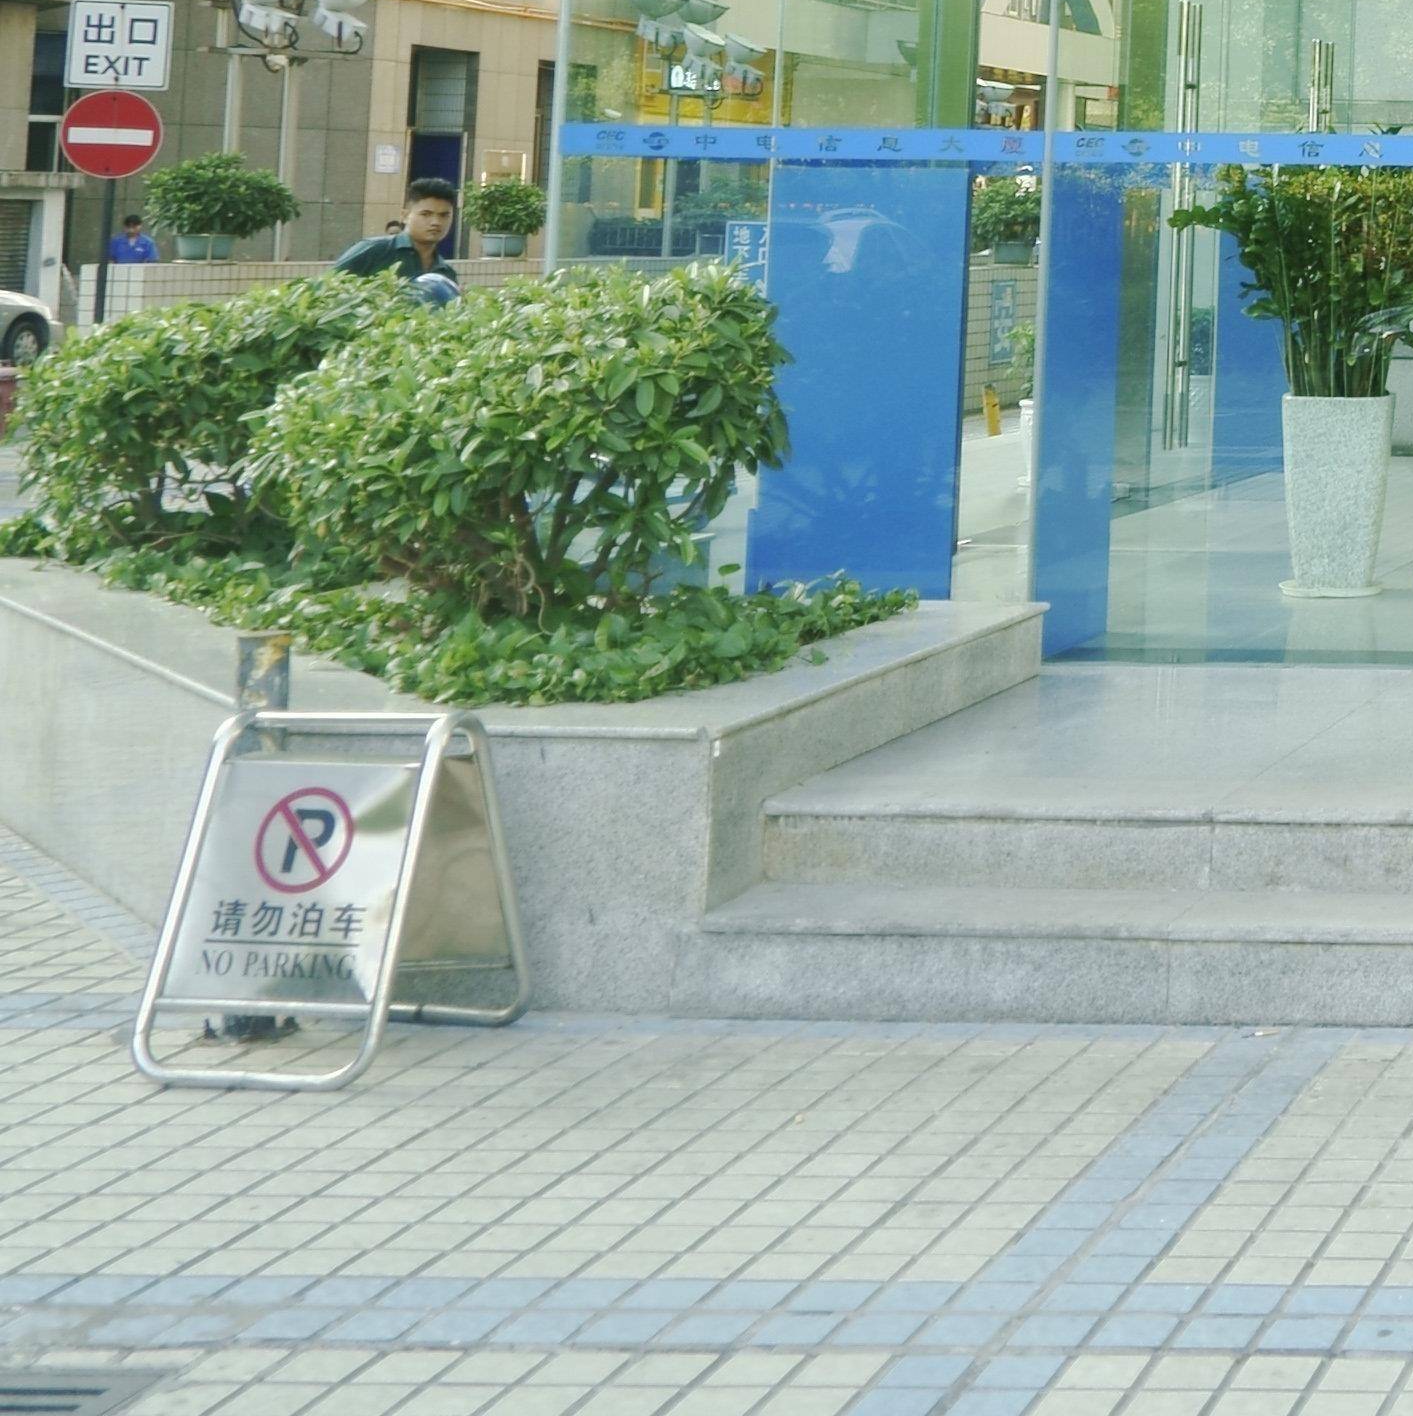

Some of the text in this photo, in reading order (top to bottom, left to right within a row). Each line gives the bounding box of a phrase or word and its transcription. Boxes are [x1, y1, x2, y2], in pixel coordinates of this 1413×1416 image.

[84, 13, 158, 44] 出口
[84, 55, 150, 76] EXIT
[695, 133, 1026, 155] 中电信息大厦
[1075, 137, 1106, 149] CEC
[211, 898, 367, 940] 请勿泊车
[196, 949, 356, 980] NO PARKING
